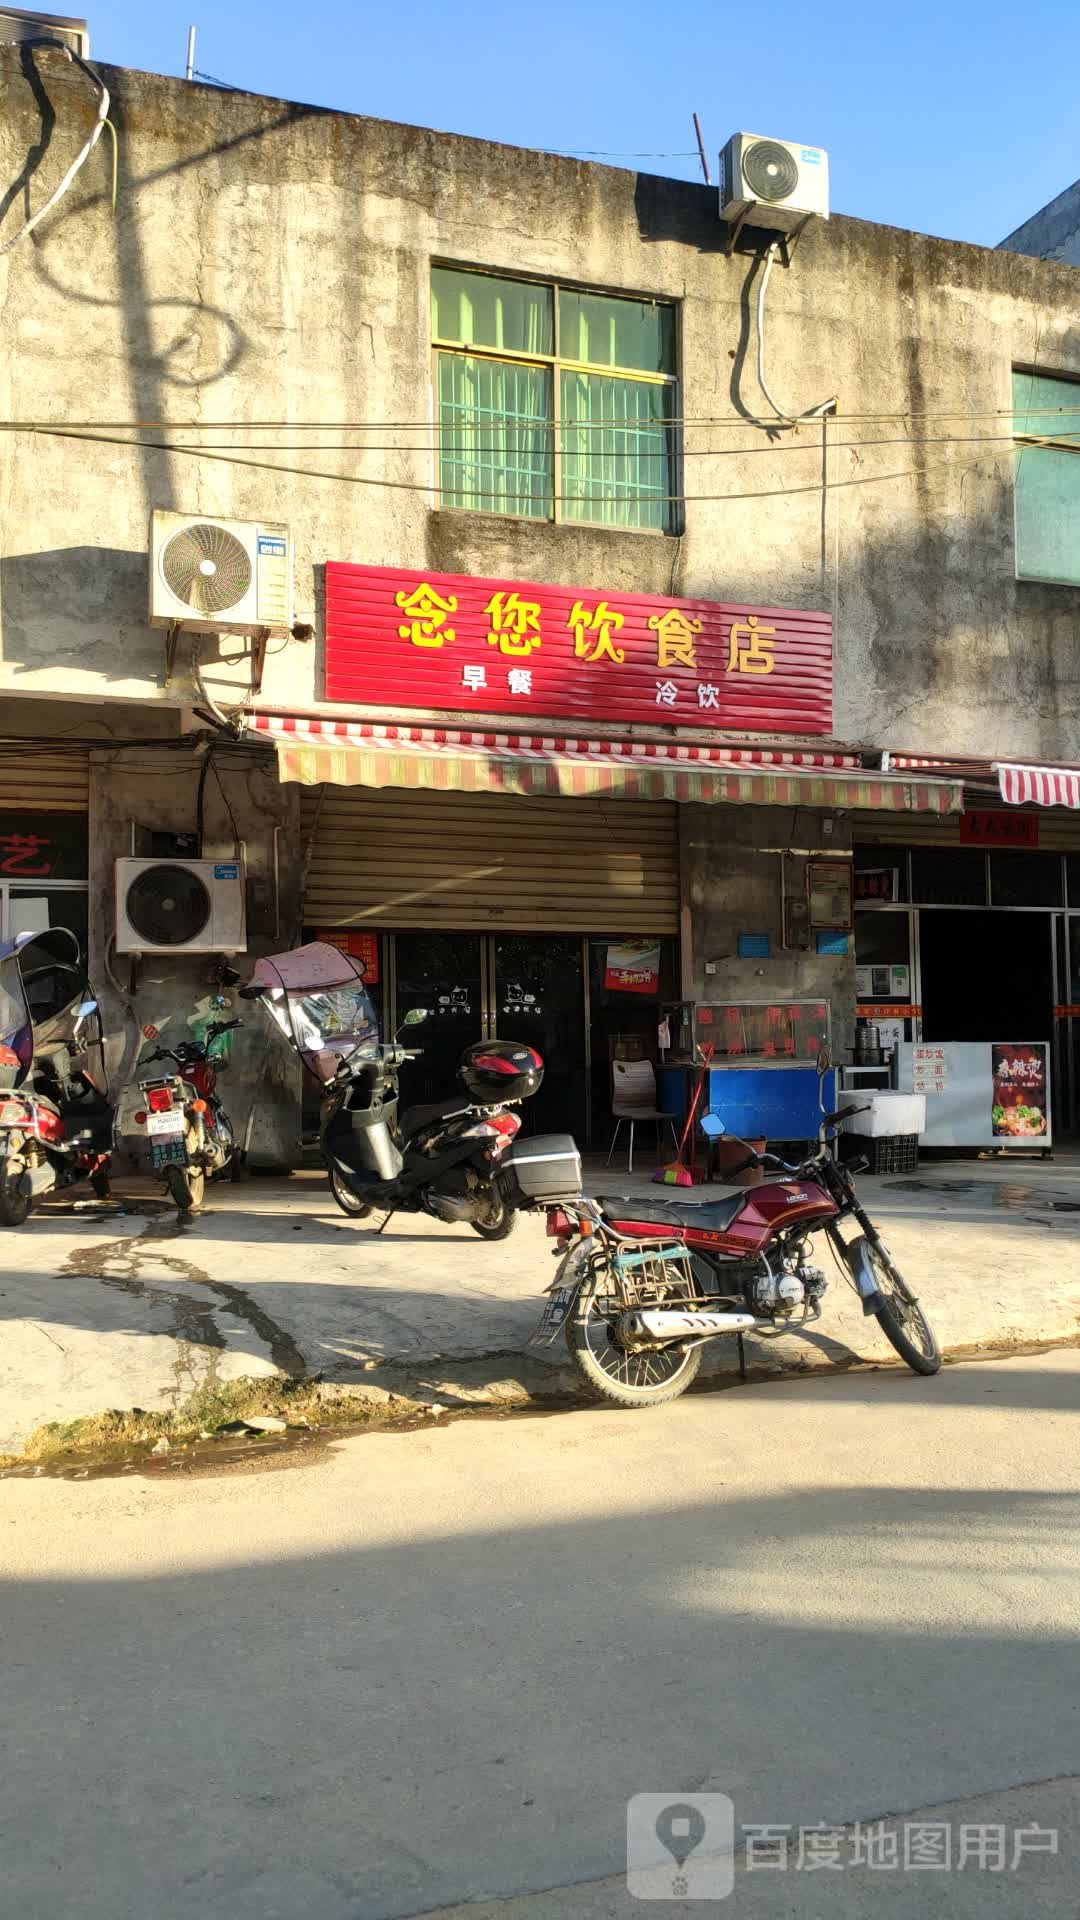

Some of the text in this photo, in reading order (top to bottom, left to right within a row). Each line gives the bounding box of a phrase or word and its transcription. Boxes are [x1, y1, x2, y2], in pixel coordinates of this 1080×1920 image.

[395, 582, 777, 675] 念您饮食店
[462, 664, 720, 709] 早餐 冷饮
[997, 1058, 1043, 1080] 麻辣烫
